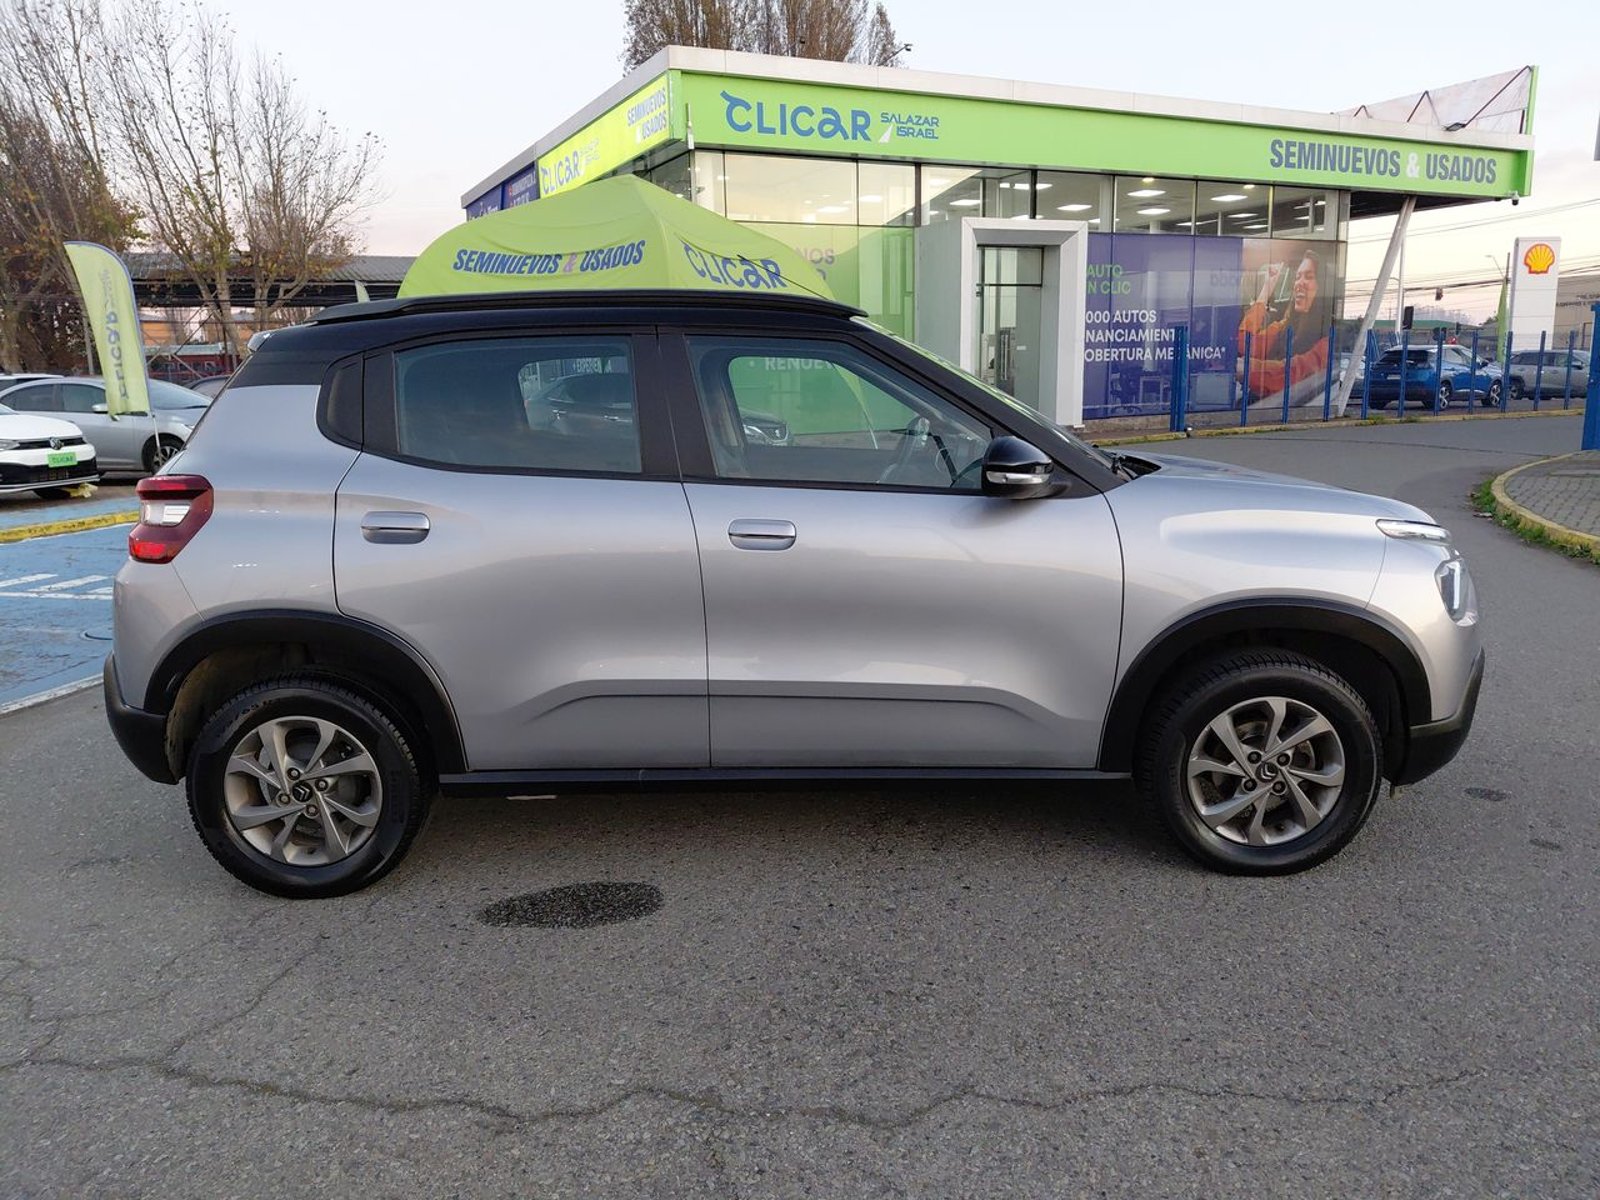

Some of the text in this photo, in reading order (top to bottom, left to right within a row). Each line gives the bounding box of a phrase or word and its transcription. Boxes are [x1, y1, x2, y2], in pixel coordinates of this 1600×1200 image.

[880, 112, 940, 128] SALAZAR
[896, 126, 939, 140] ISRAEL
[1269, 139, 1498, 185] SEMINUEVOS & USADOS
[453, 249, 563, 275] SEMINUEVOS
[579, 239, 646, 273] USADOS
[1087, 264, 1122, 278] AUTO
[1087, 281, 1131, 294] N CLIC
[1113, 309, 1157, 323] AUTOS
[1085, 328, 1175, 343] NANCIAMIENT
[1085, 347, 1152, 361] OBERTURA
